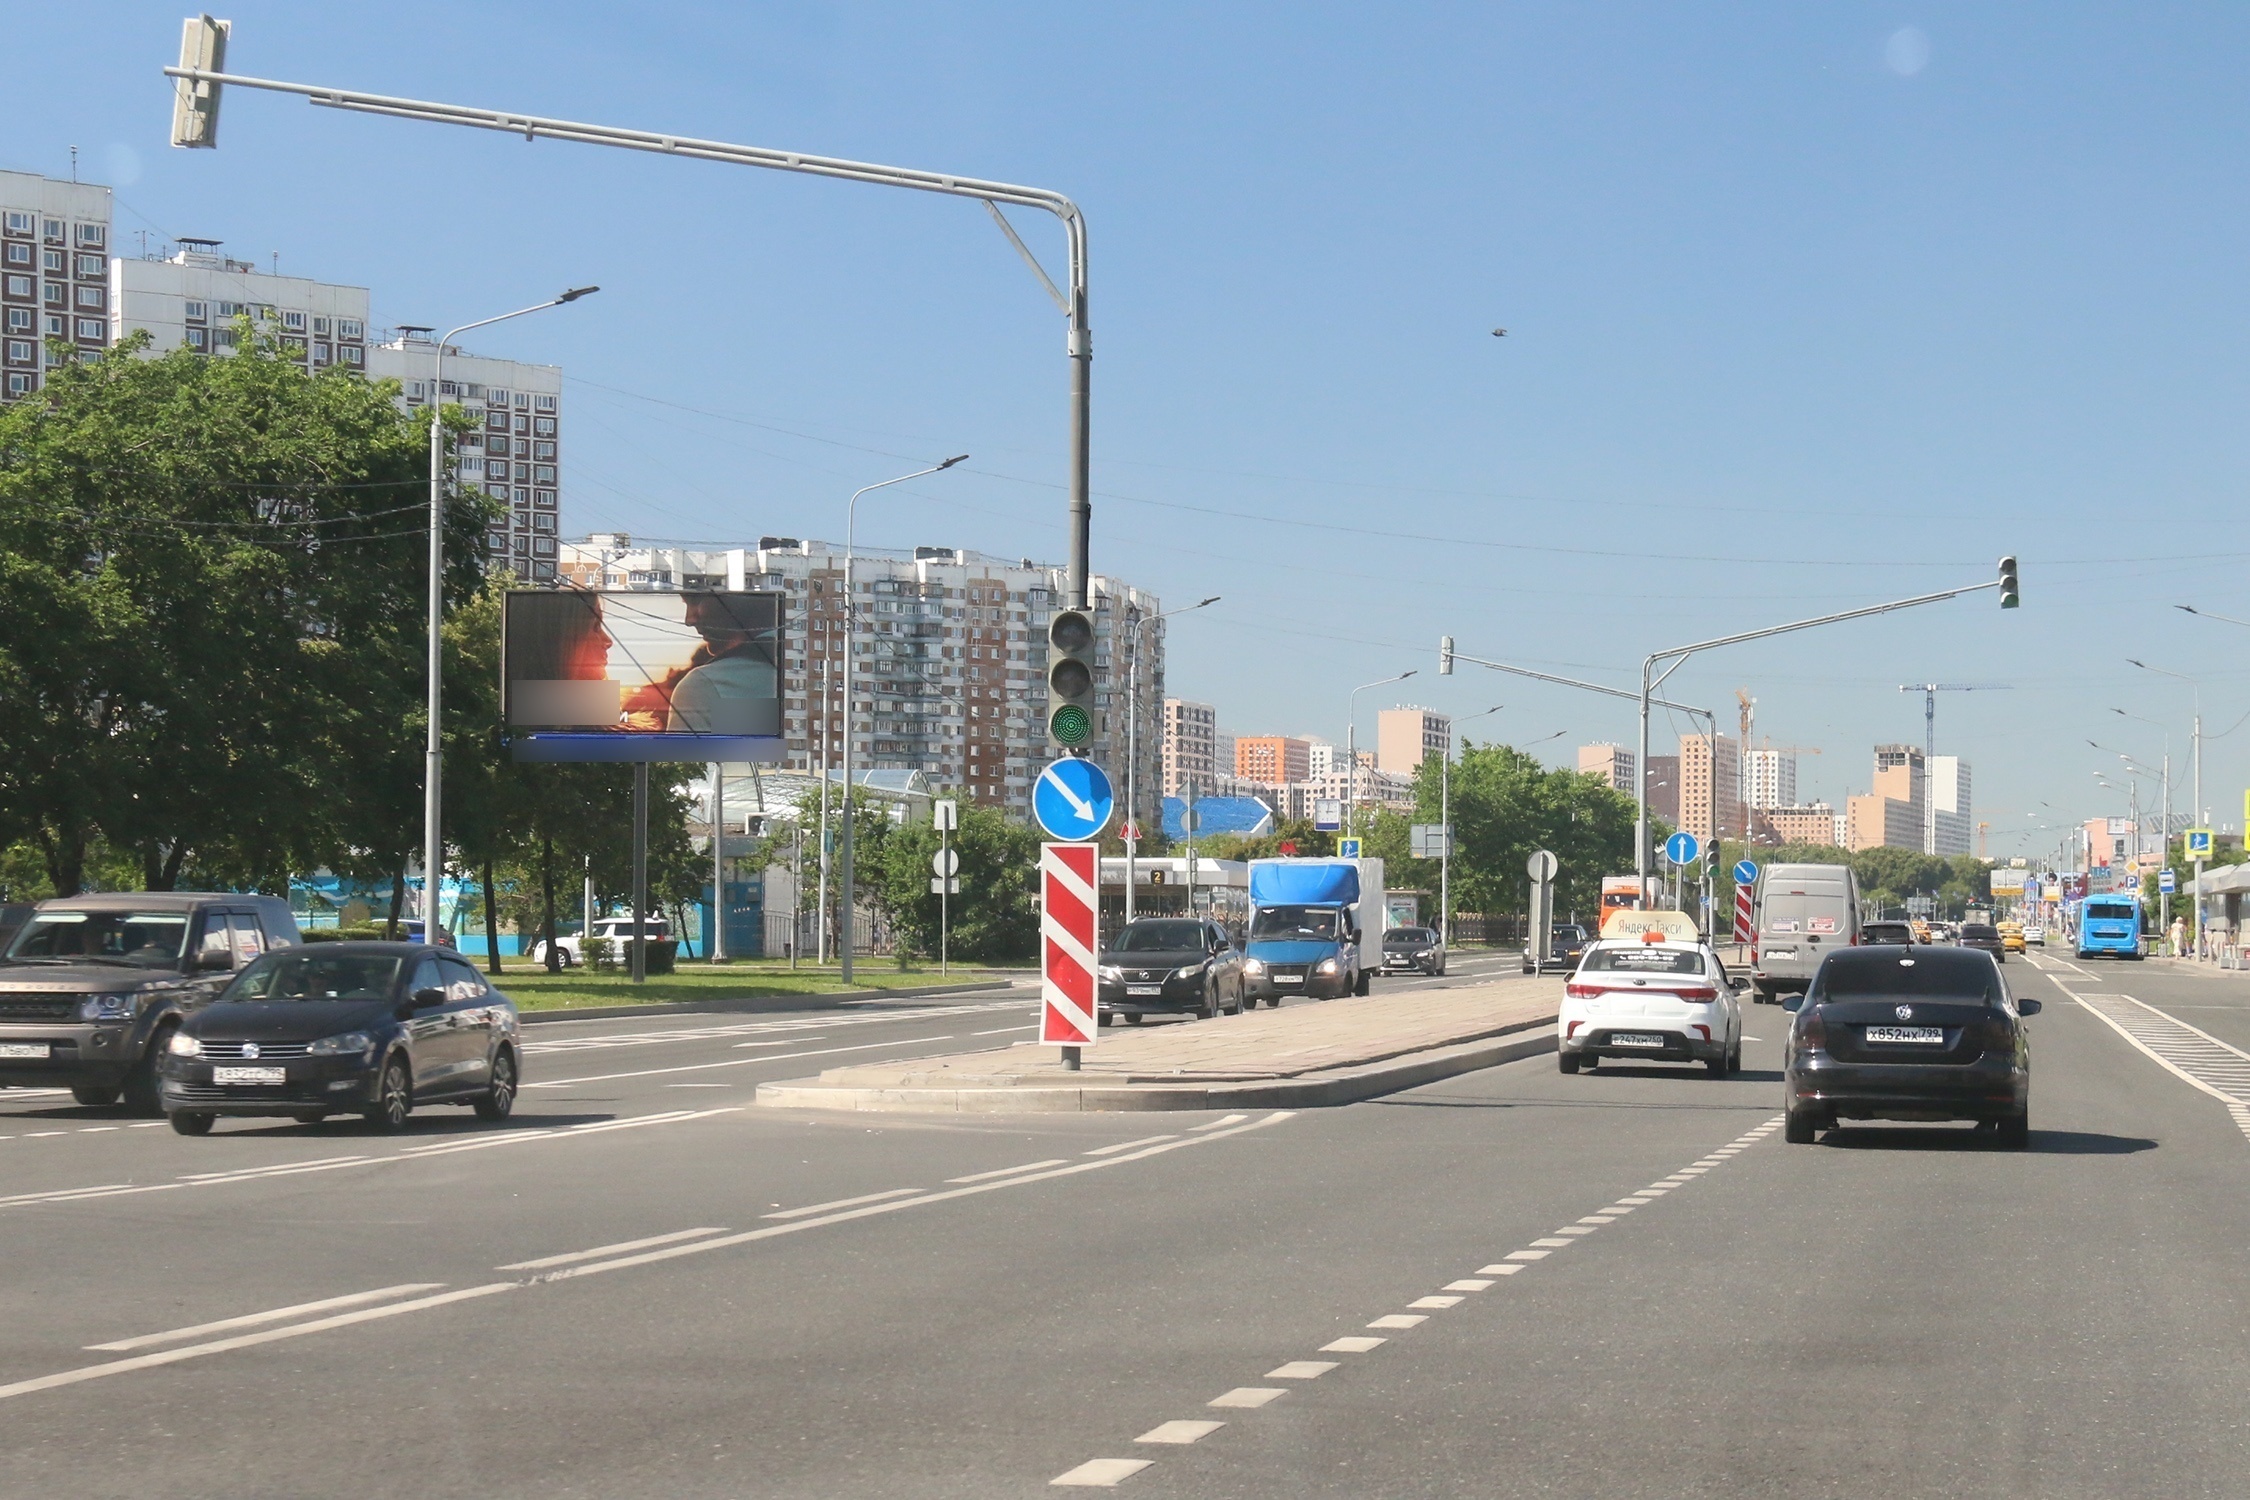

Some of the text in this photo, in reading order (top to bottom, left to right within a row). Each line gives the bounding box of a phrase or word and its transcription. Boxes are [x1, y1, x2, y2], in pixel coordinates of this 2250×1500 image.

[1154, 871, 1161, 881] 2
[2127, 877, 2136, 887] P
[1618, 919, 1682, 934] Яндекс Такси
[1920, 1028, 1939, 1038] 799
